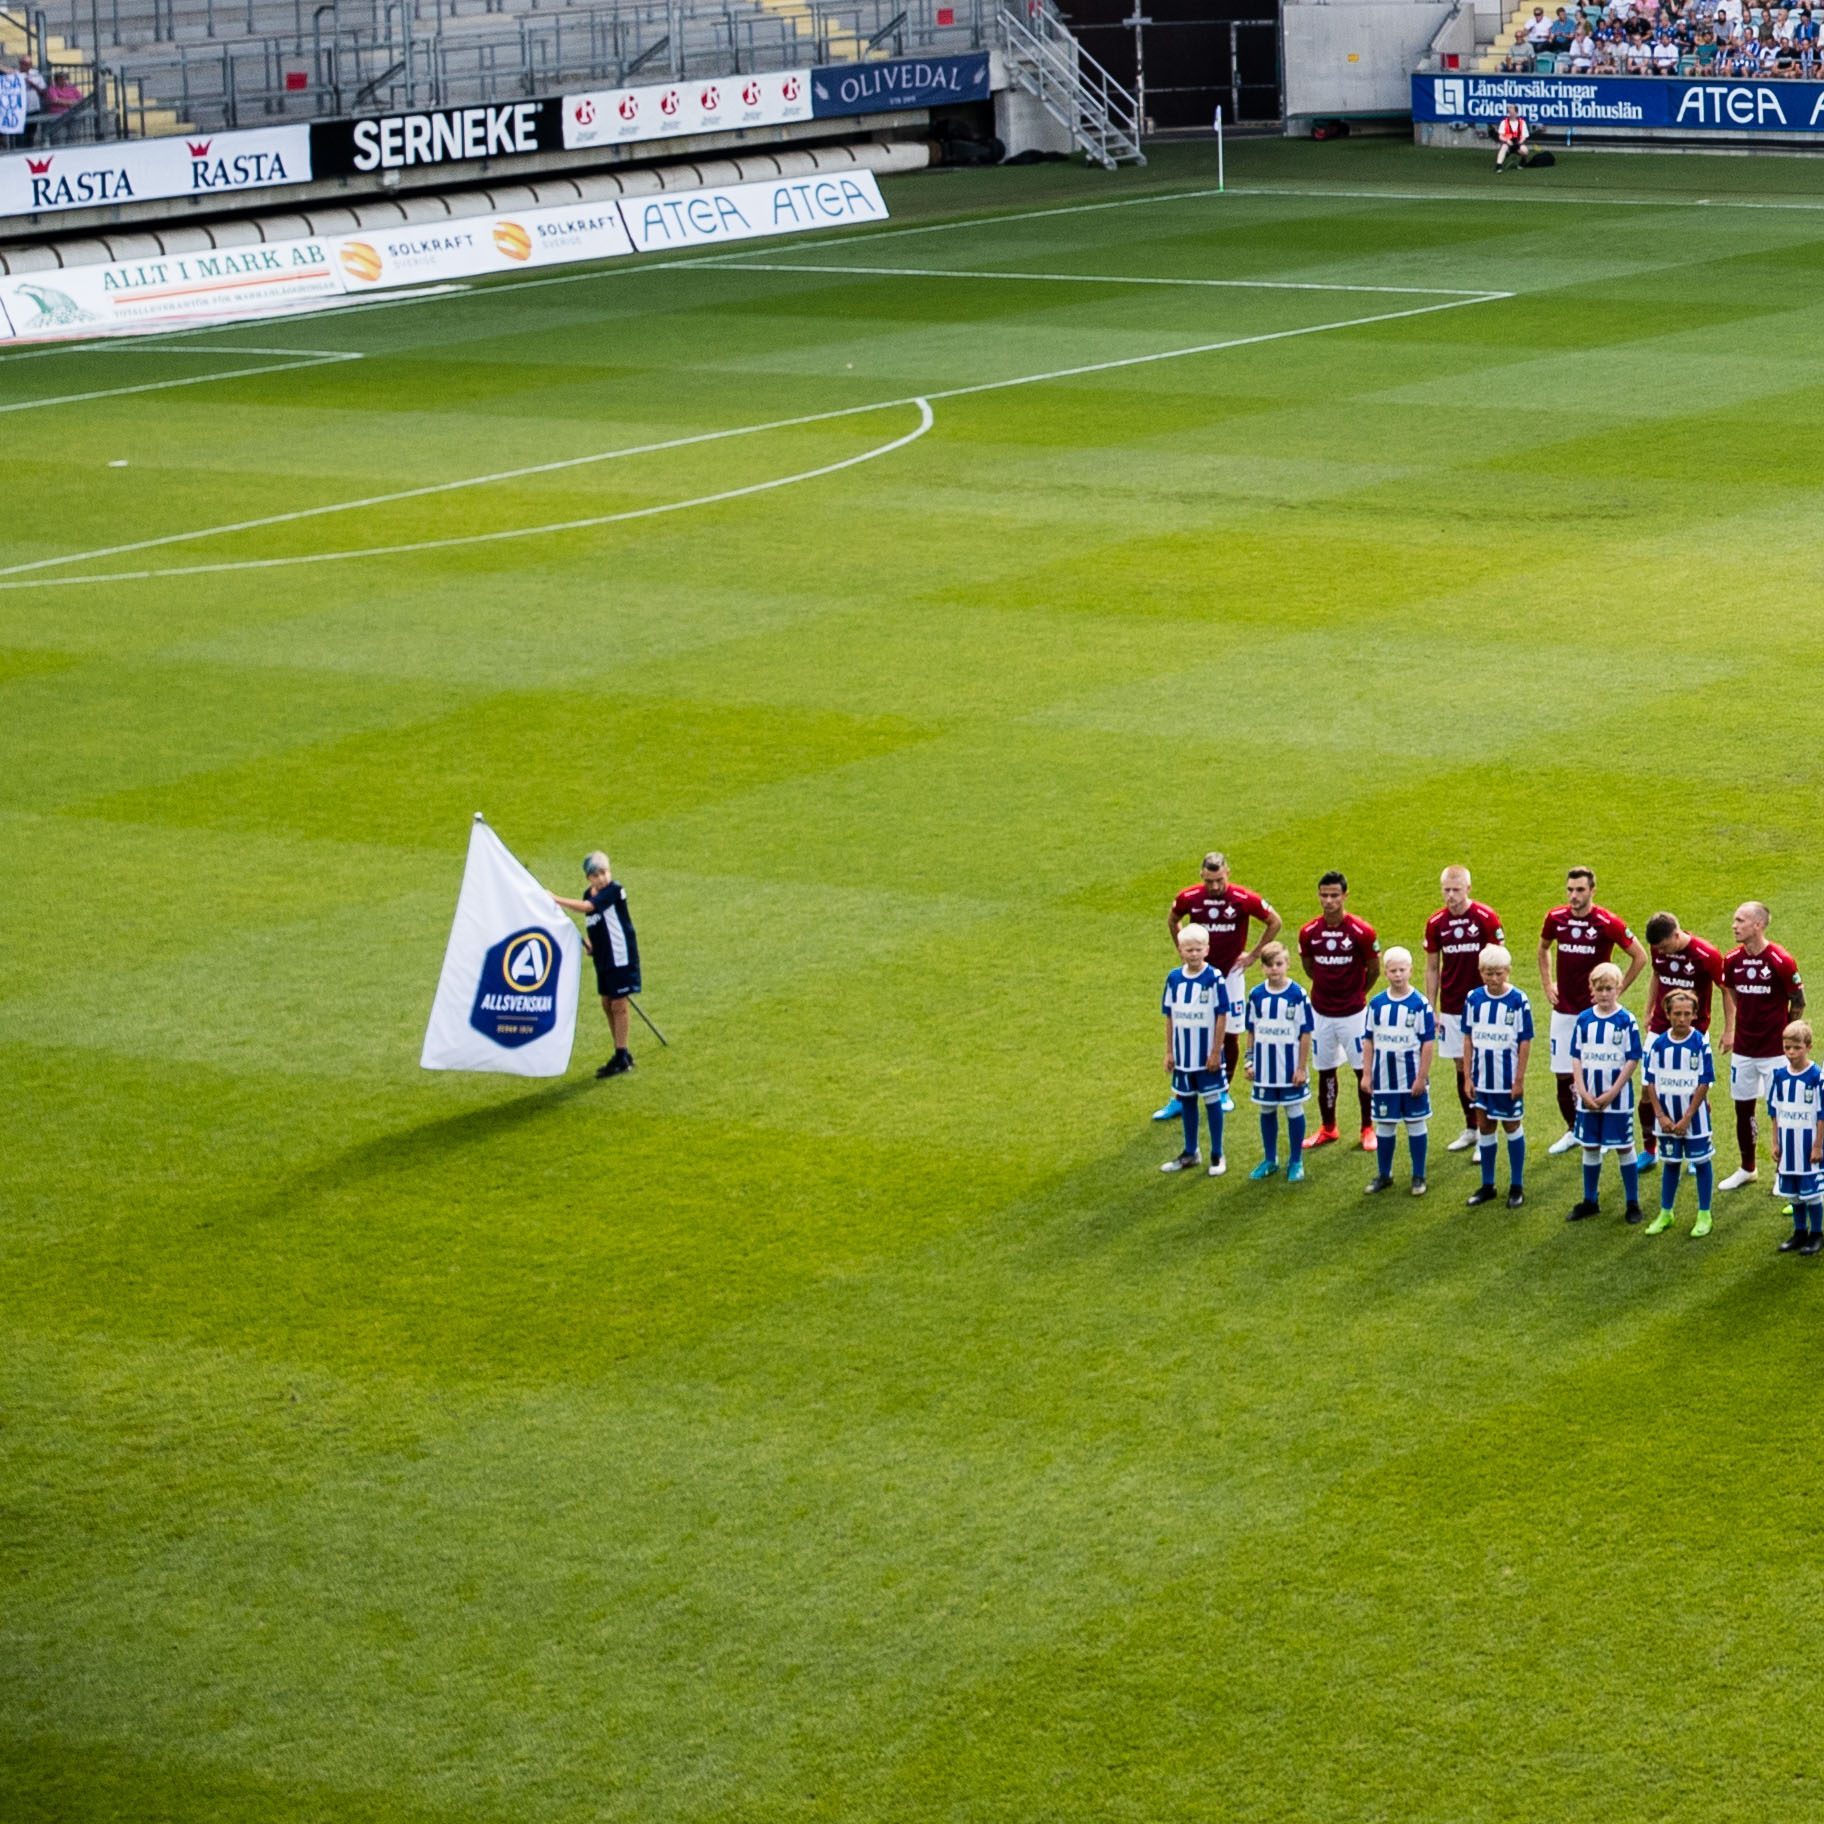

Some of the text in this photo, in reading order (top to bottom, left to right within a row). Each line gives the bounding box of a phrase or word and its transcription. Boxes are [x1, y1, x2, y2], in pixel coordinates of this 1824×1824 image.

[840, 64, 963, 103] OLIVEDAL
[1468, 79, 1598, 101] Länsförsäkringar
[1540, 100, 1569, 118] och
[1570, 101, 1643, 120] Bohuslän
[1676, 87, 1787, 125] ATEA
[353, 103, 538, 171] SERNEKE
[192, 153, 287, 188] RASTA
[32, 168, 134, 207] RASTA
[773, 179, 876, 226] ATEA
[537, 216, 616, 238] SOLKRAFT
[643, 195, 751, 242] ATEA
[387, 234, 475, 257] SOLKRAFT
[104, 244, 326, 291] ALLT I MARK AB
[1206, 922, 1236, 933] OLMEN
[1443, 943, 1480, 954] HOLMEN
[1558, 943, 1595, 954] HOLMEN
[1315, 955, 1353, 966] HOLMEN
[1735, 984, 1771, 994] HOLMEN
